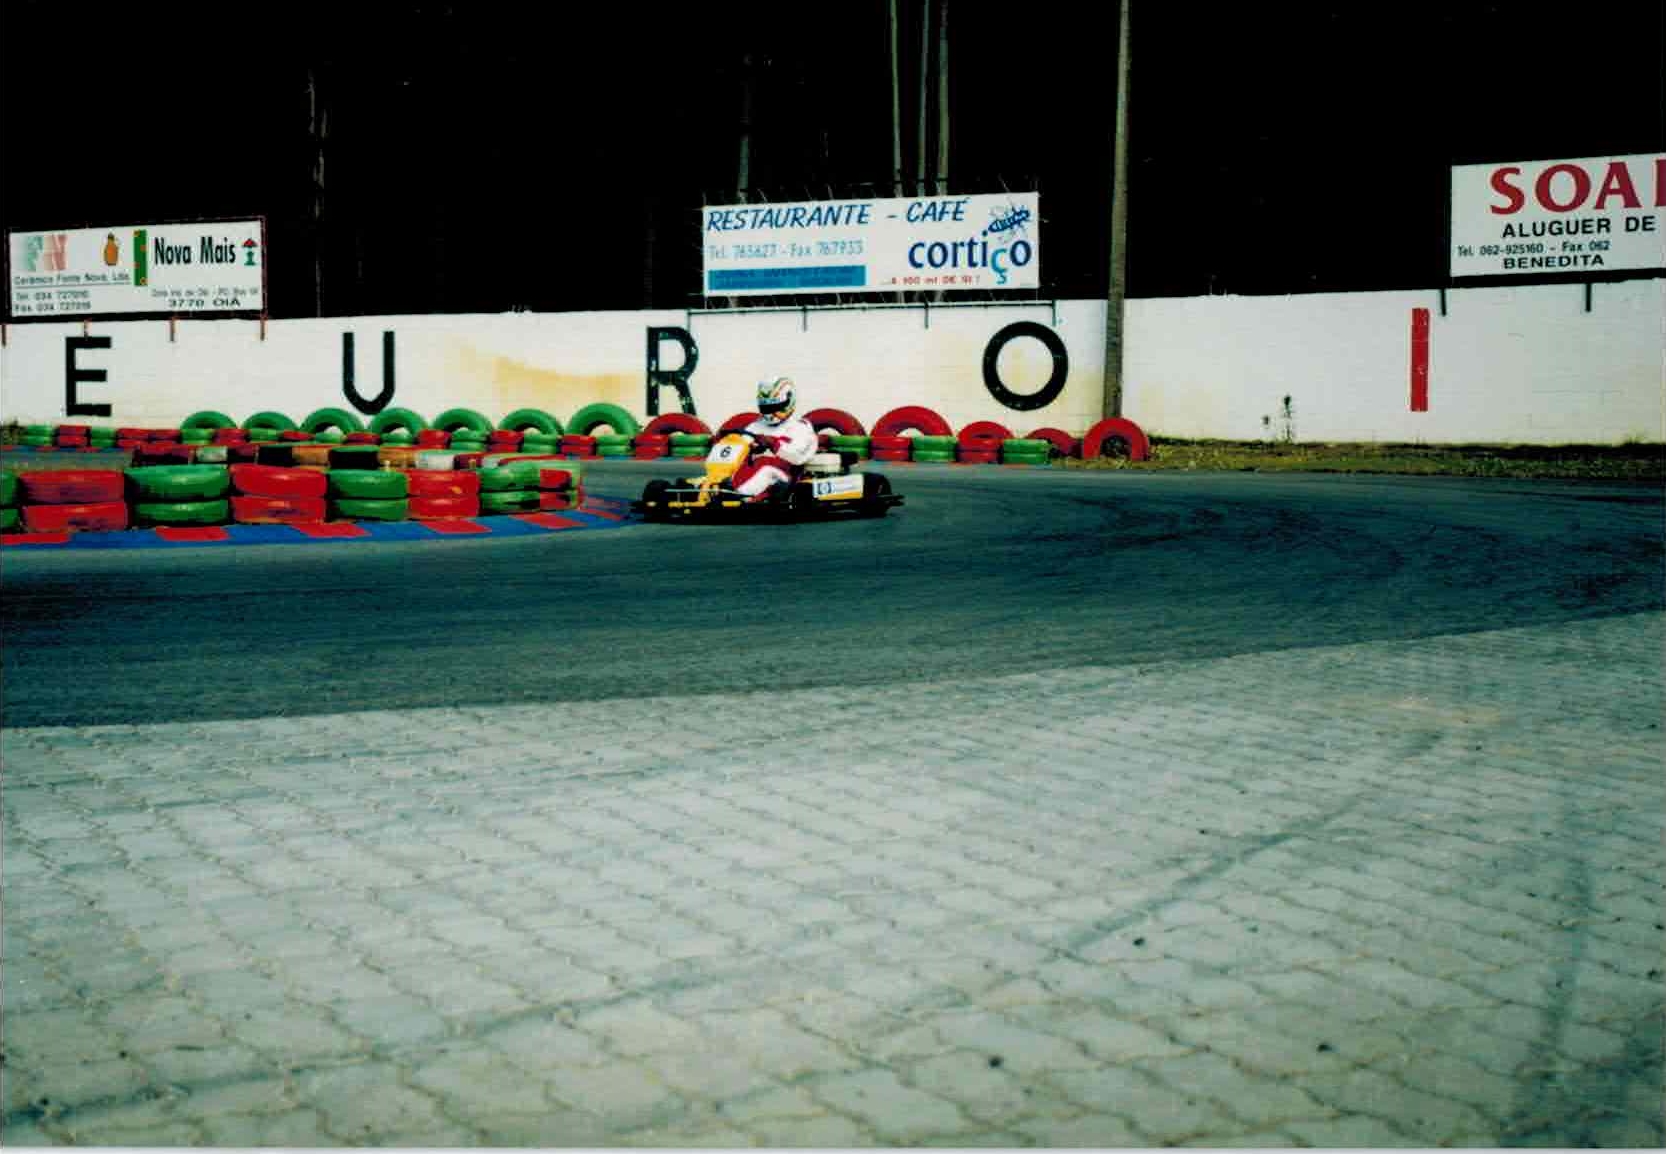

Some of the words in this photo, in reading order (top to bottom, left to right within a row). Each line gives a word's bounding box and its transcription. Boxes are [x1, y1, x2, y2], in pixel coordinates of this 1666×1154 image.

[707, 203, 872, 232] RESTAURANTE
[907, 197, 971, 223] CAFÉ
[1502, 218, 1612, 238] ALUGUER
[1625, 215, 1656, 232] DE
[154, 236, 192, 265] Nova
[200, 235, 237, 264] Mais
[908, 230, 1032, 285] cortiço
[1562, 240, 1584, 253] Fax
[1588, 239, 1611, 251] 062
[1503, 254, 1605, 269] BENEDITA
[720, 446, 732, 459] 6
